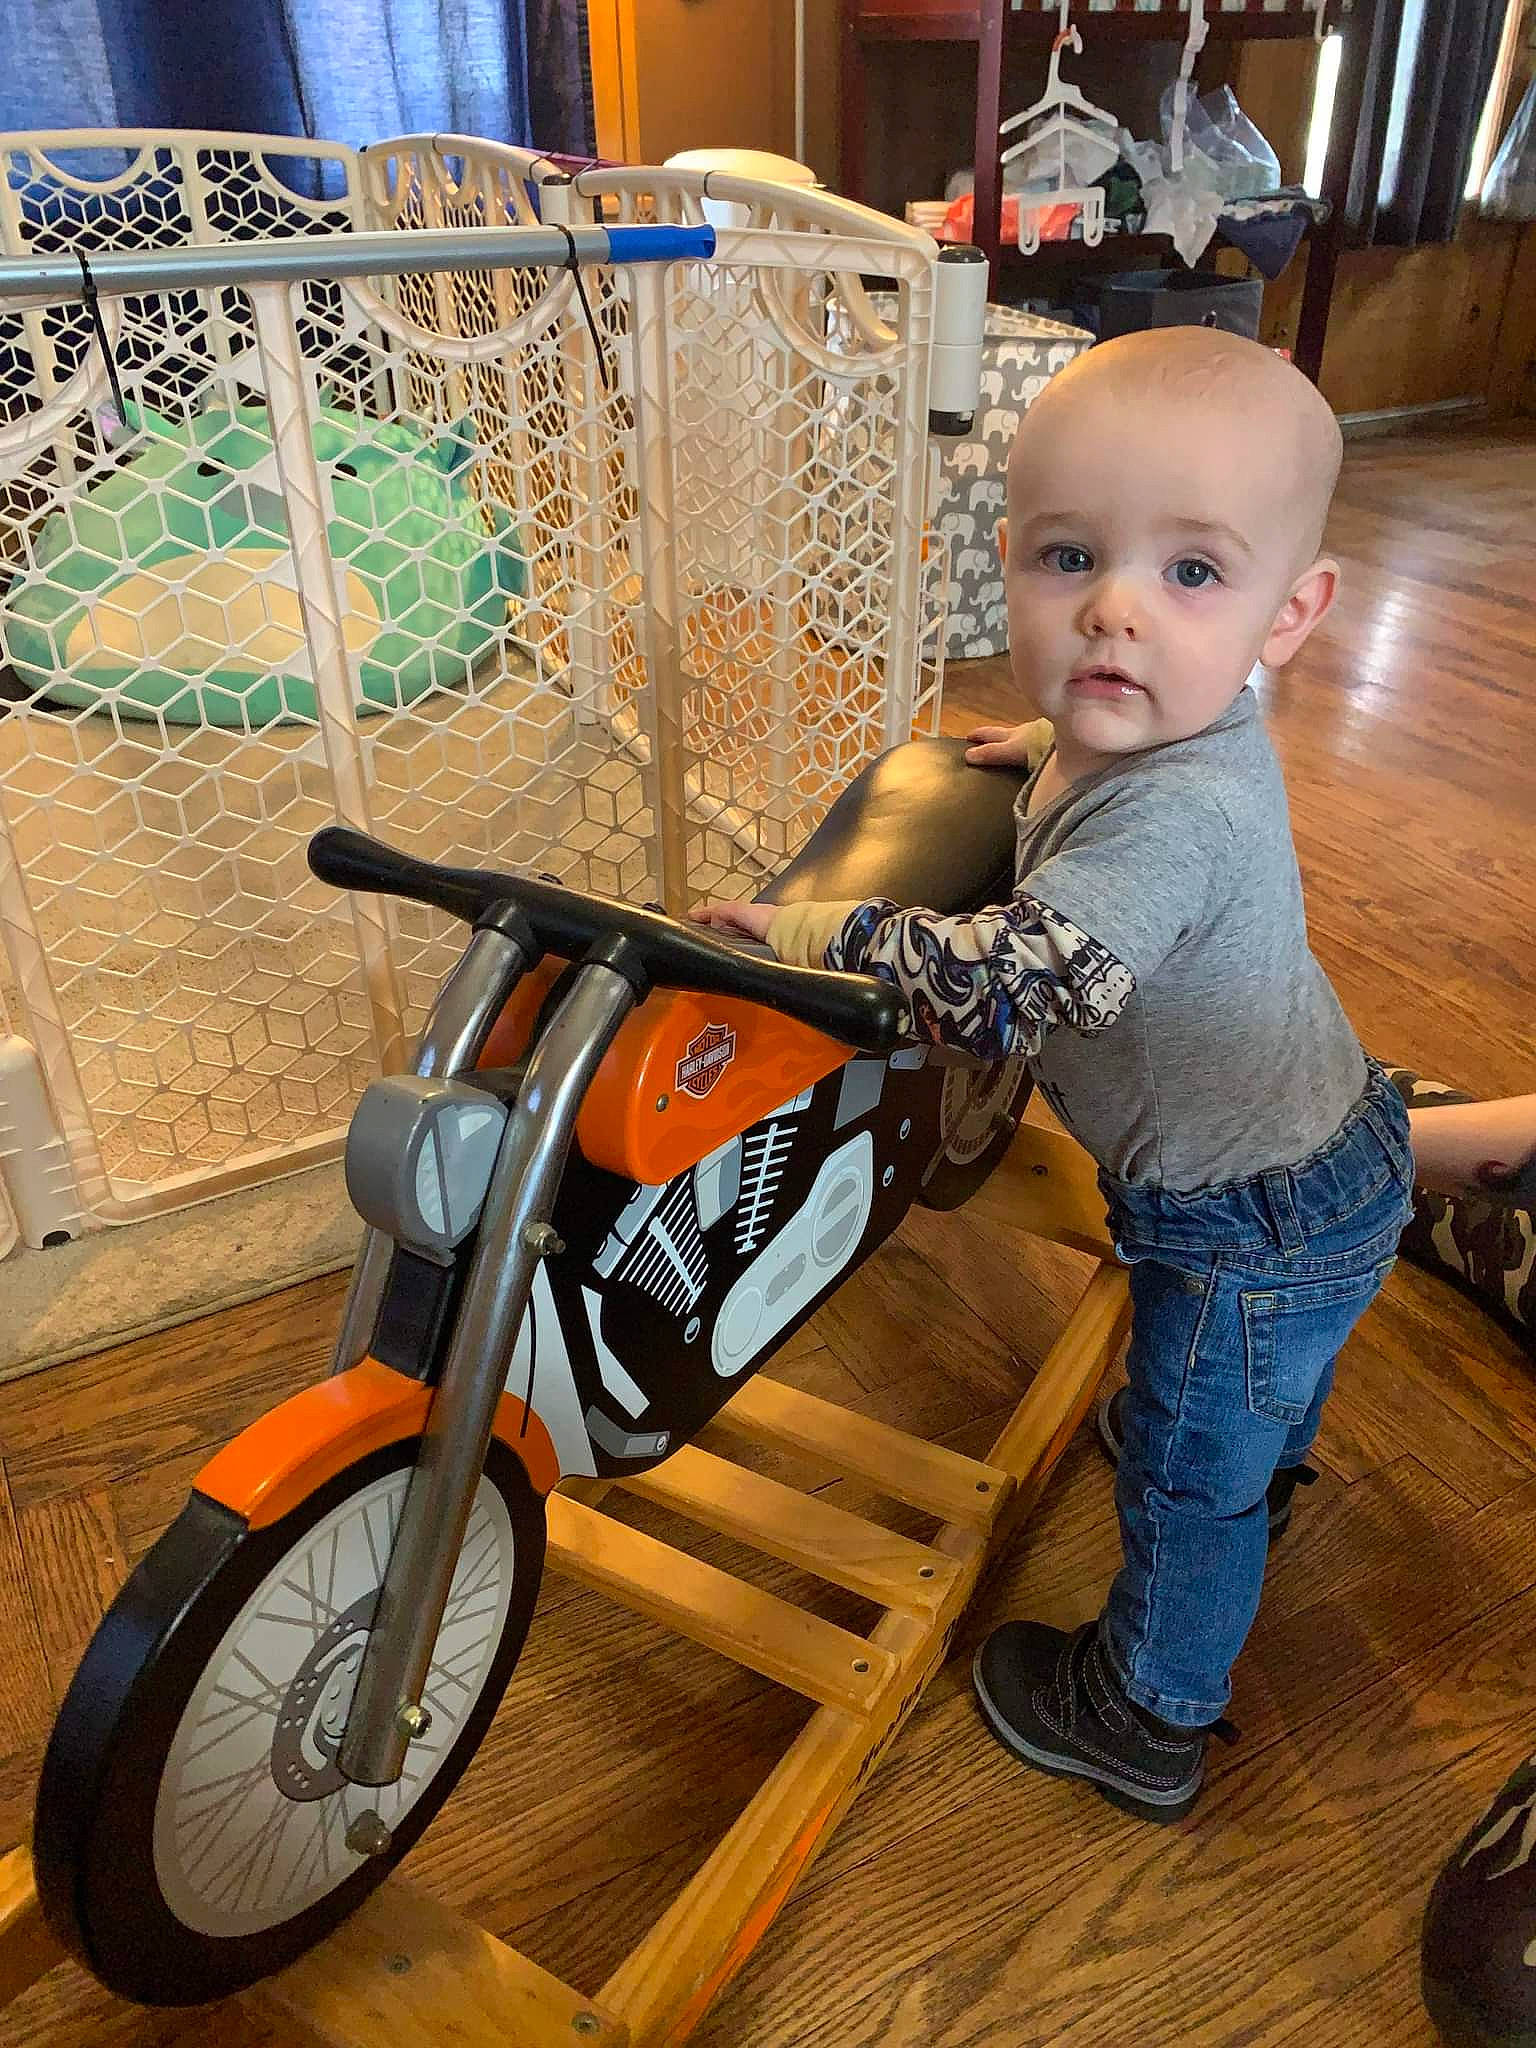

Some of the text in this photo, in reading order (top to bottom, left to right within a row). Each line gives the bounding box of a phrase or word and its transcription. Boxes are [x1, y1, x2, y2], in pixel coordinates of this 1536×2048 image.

[694, 1033, 720, 1054] MOTOR
[681, 1042, 730, 1080] HARLEY-DAVIDSON
[691, 1067, 720, 1090] CYCLES
